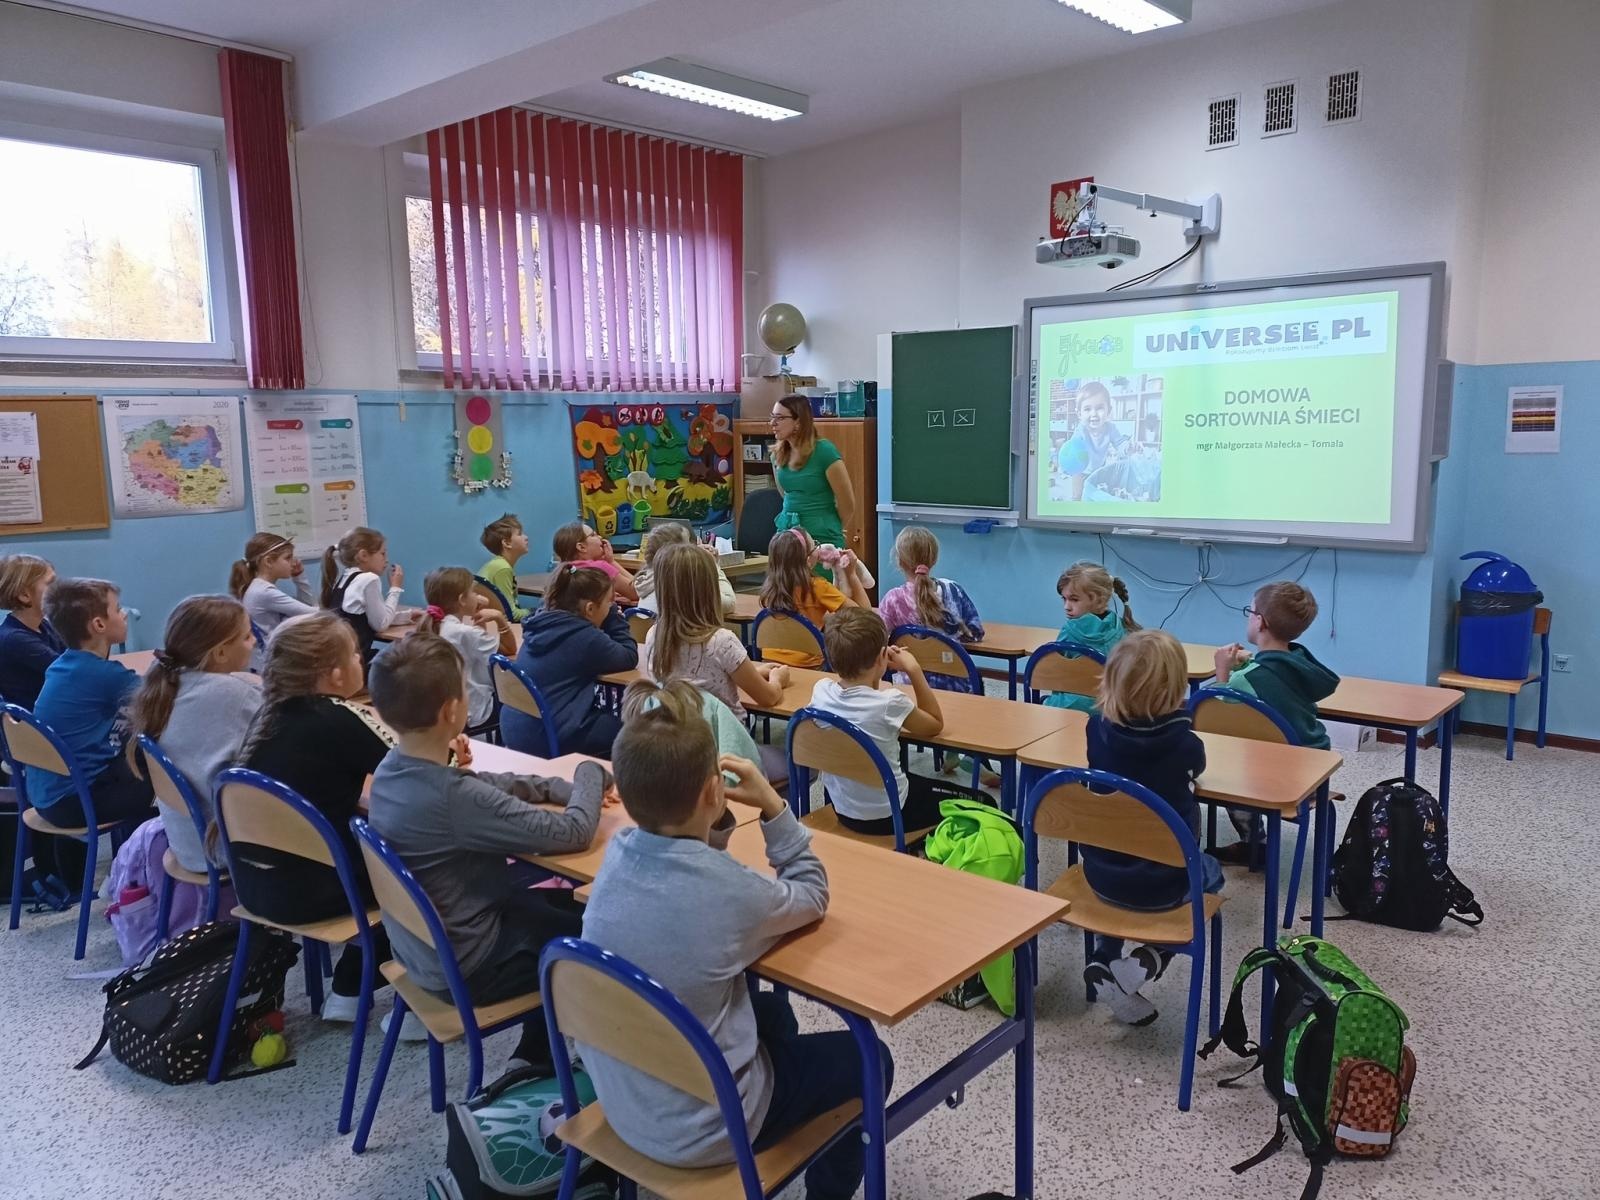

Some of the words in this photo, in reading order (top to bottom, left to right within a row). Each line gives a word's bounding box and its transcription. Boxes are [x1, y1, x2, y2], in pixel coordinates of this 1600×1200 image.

[1224, 387, 1311, 405] DOMOWA
[213, 401, 230, 409] 2020
[1184, 409, 1291, 428] SORTOWNIA
[1295, 405, 1360, 425] ŚMIECI
[1196, 442, 1213, 452] mgr
